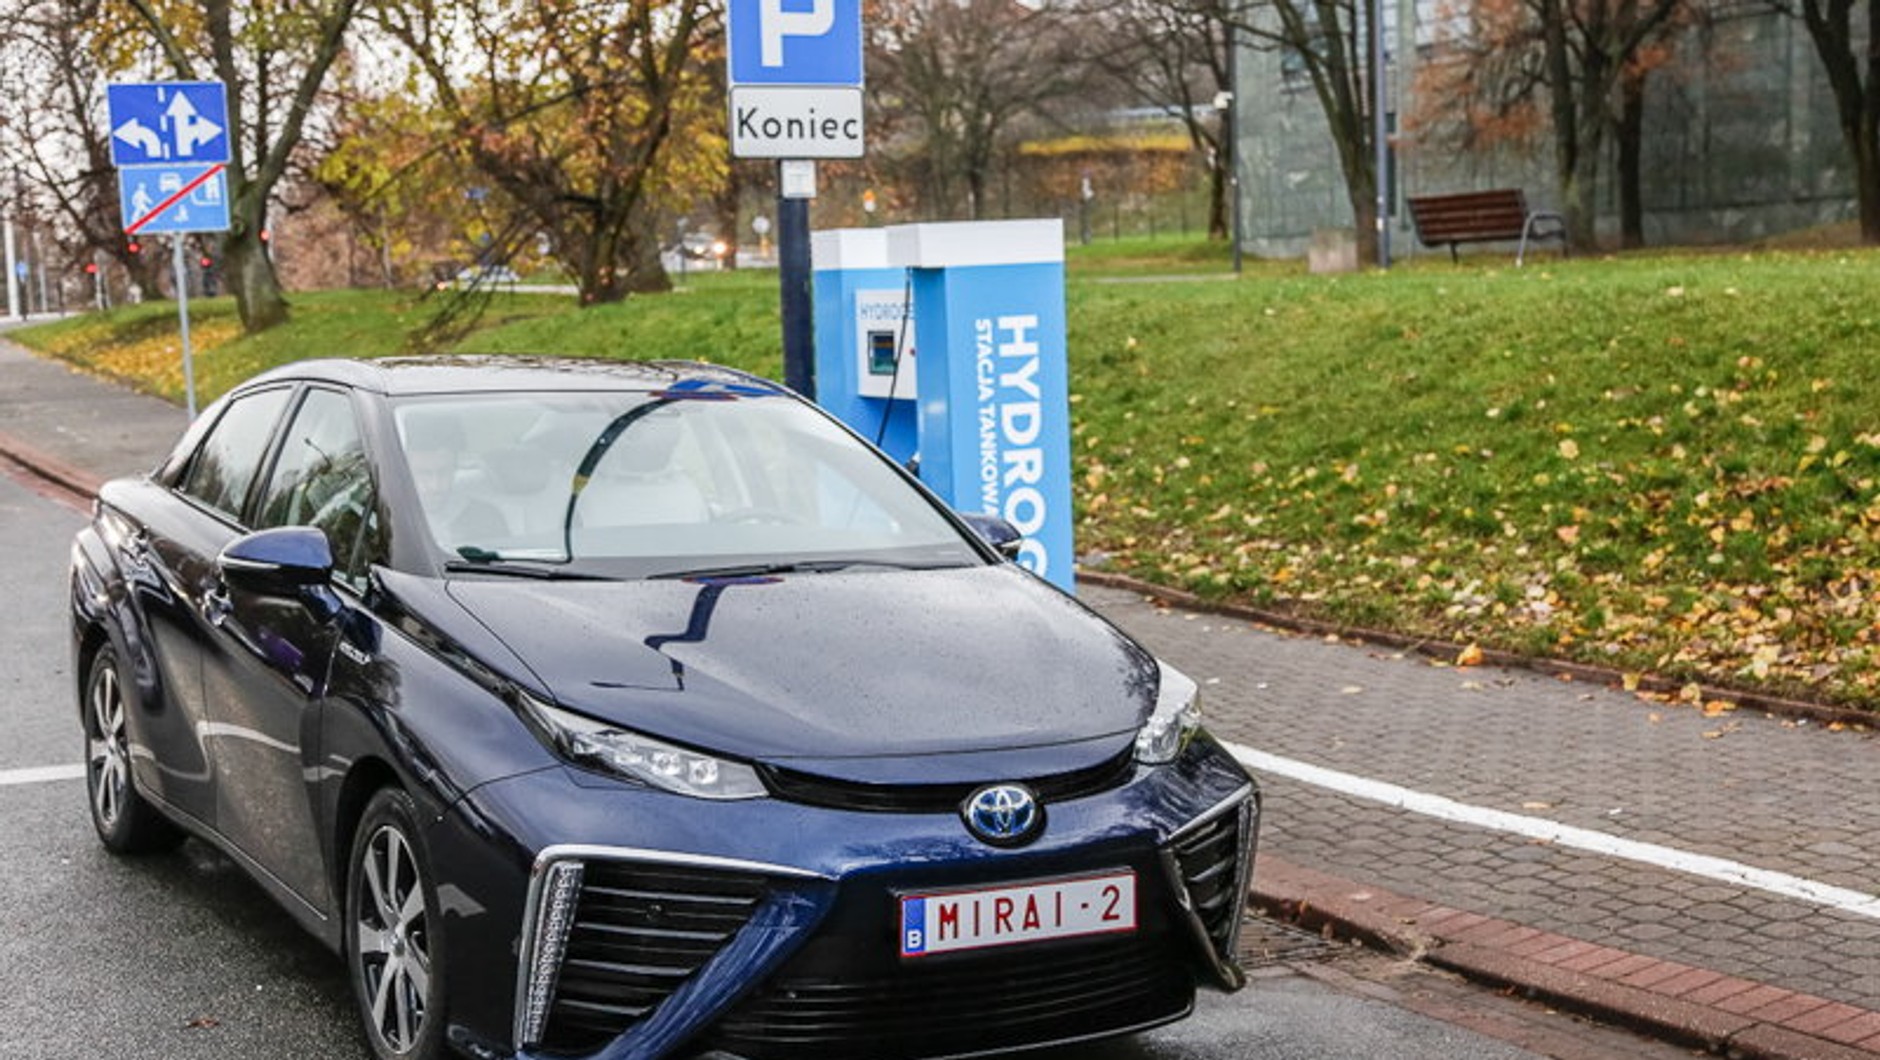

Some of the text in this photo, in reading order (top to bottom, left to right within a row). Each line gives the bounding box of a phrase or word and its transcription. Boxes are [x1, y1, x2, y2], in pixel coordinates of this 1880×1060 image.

[759, 0, 835, 66] P
[737, 107, 858, 140] Koniec
[975, 318, 994, 401] STACJA
[907, 931, 922, 949] B
